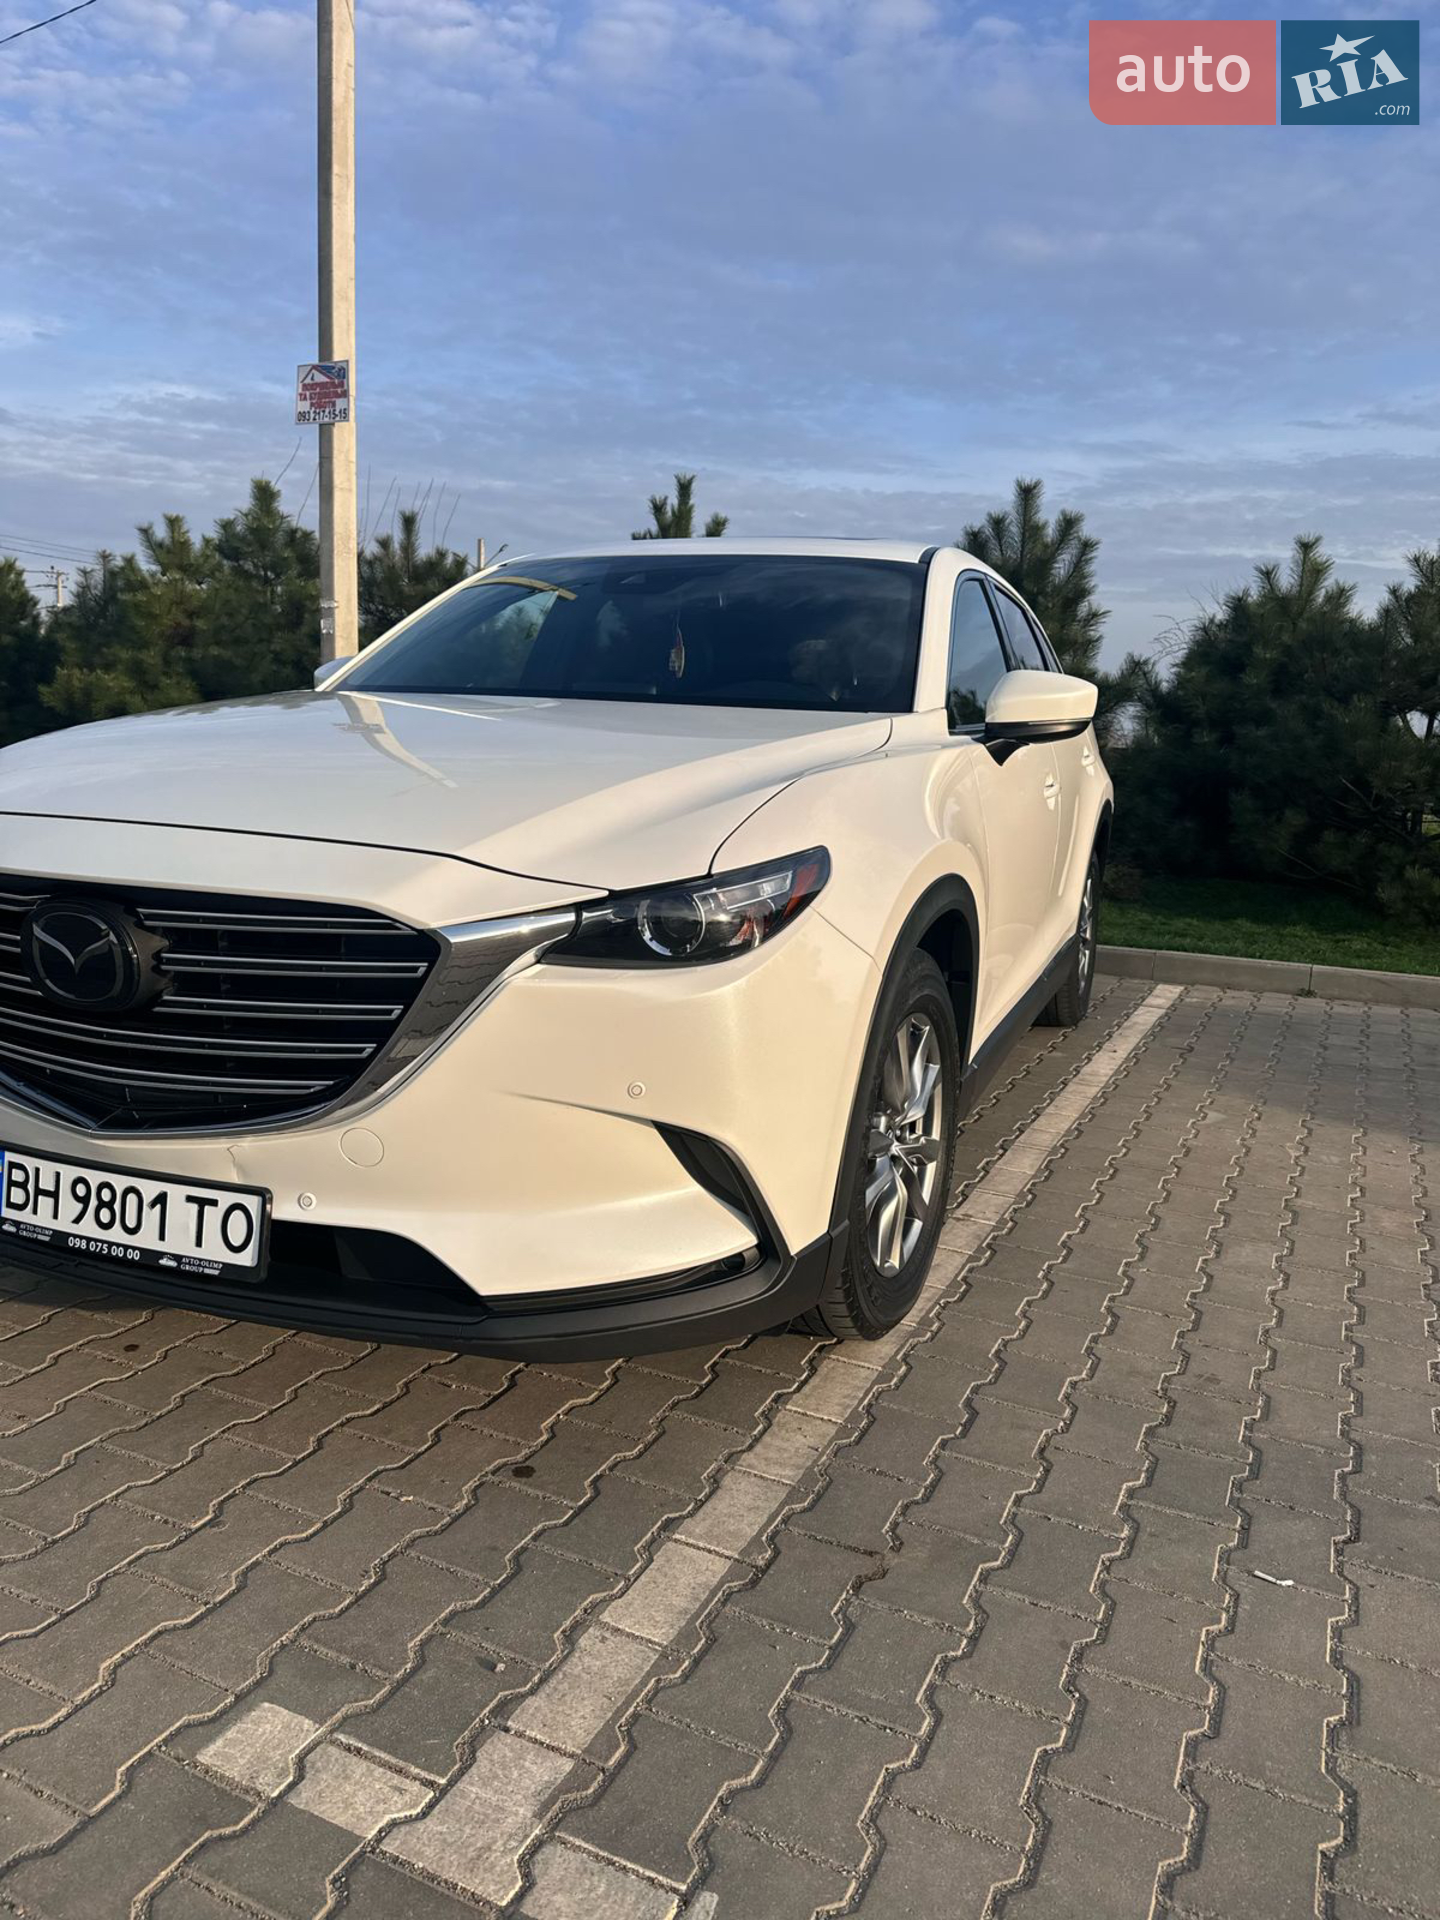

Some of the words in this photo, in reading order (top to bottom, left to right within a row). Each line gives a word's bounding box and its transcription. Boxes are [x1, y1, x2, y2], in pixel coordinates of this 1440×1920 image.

[297, 410, 311, 422] 093
[312, 408, 347, 421] 217-15-15
[5, 1160, 61, 1220] BH
[70, 1175, 169, 1242] 9801
[185, 1194, 254, 1254] TO
[68, 1236, 87, 1250] 098
[89, 1241, 109, 1254] 075
[111, 1245, 125, 1258] 00
[126, 1249, 140, 1261] 00
[180, 1264, 204, 1273] GROUP
[181, 1257, 223, 1269] AVTO-OLIMP
